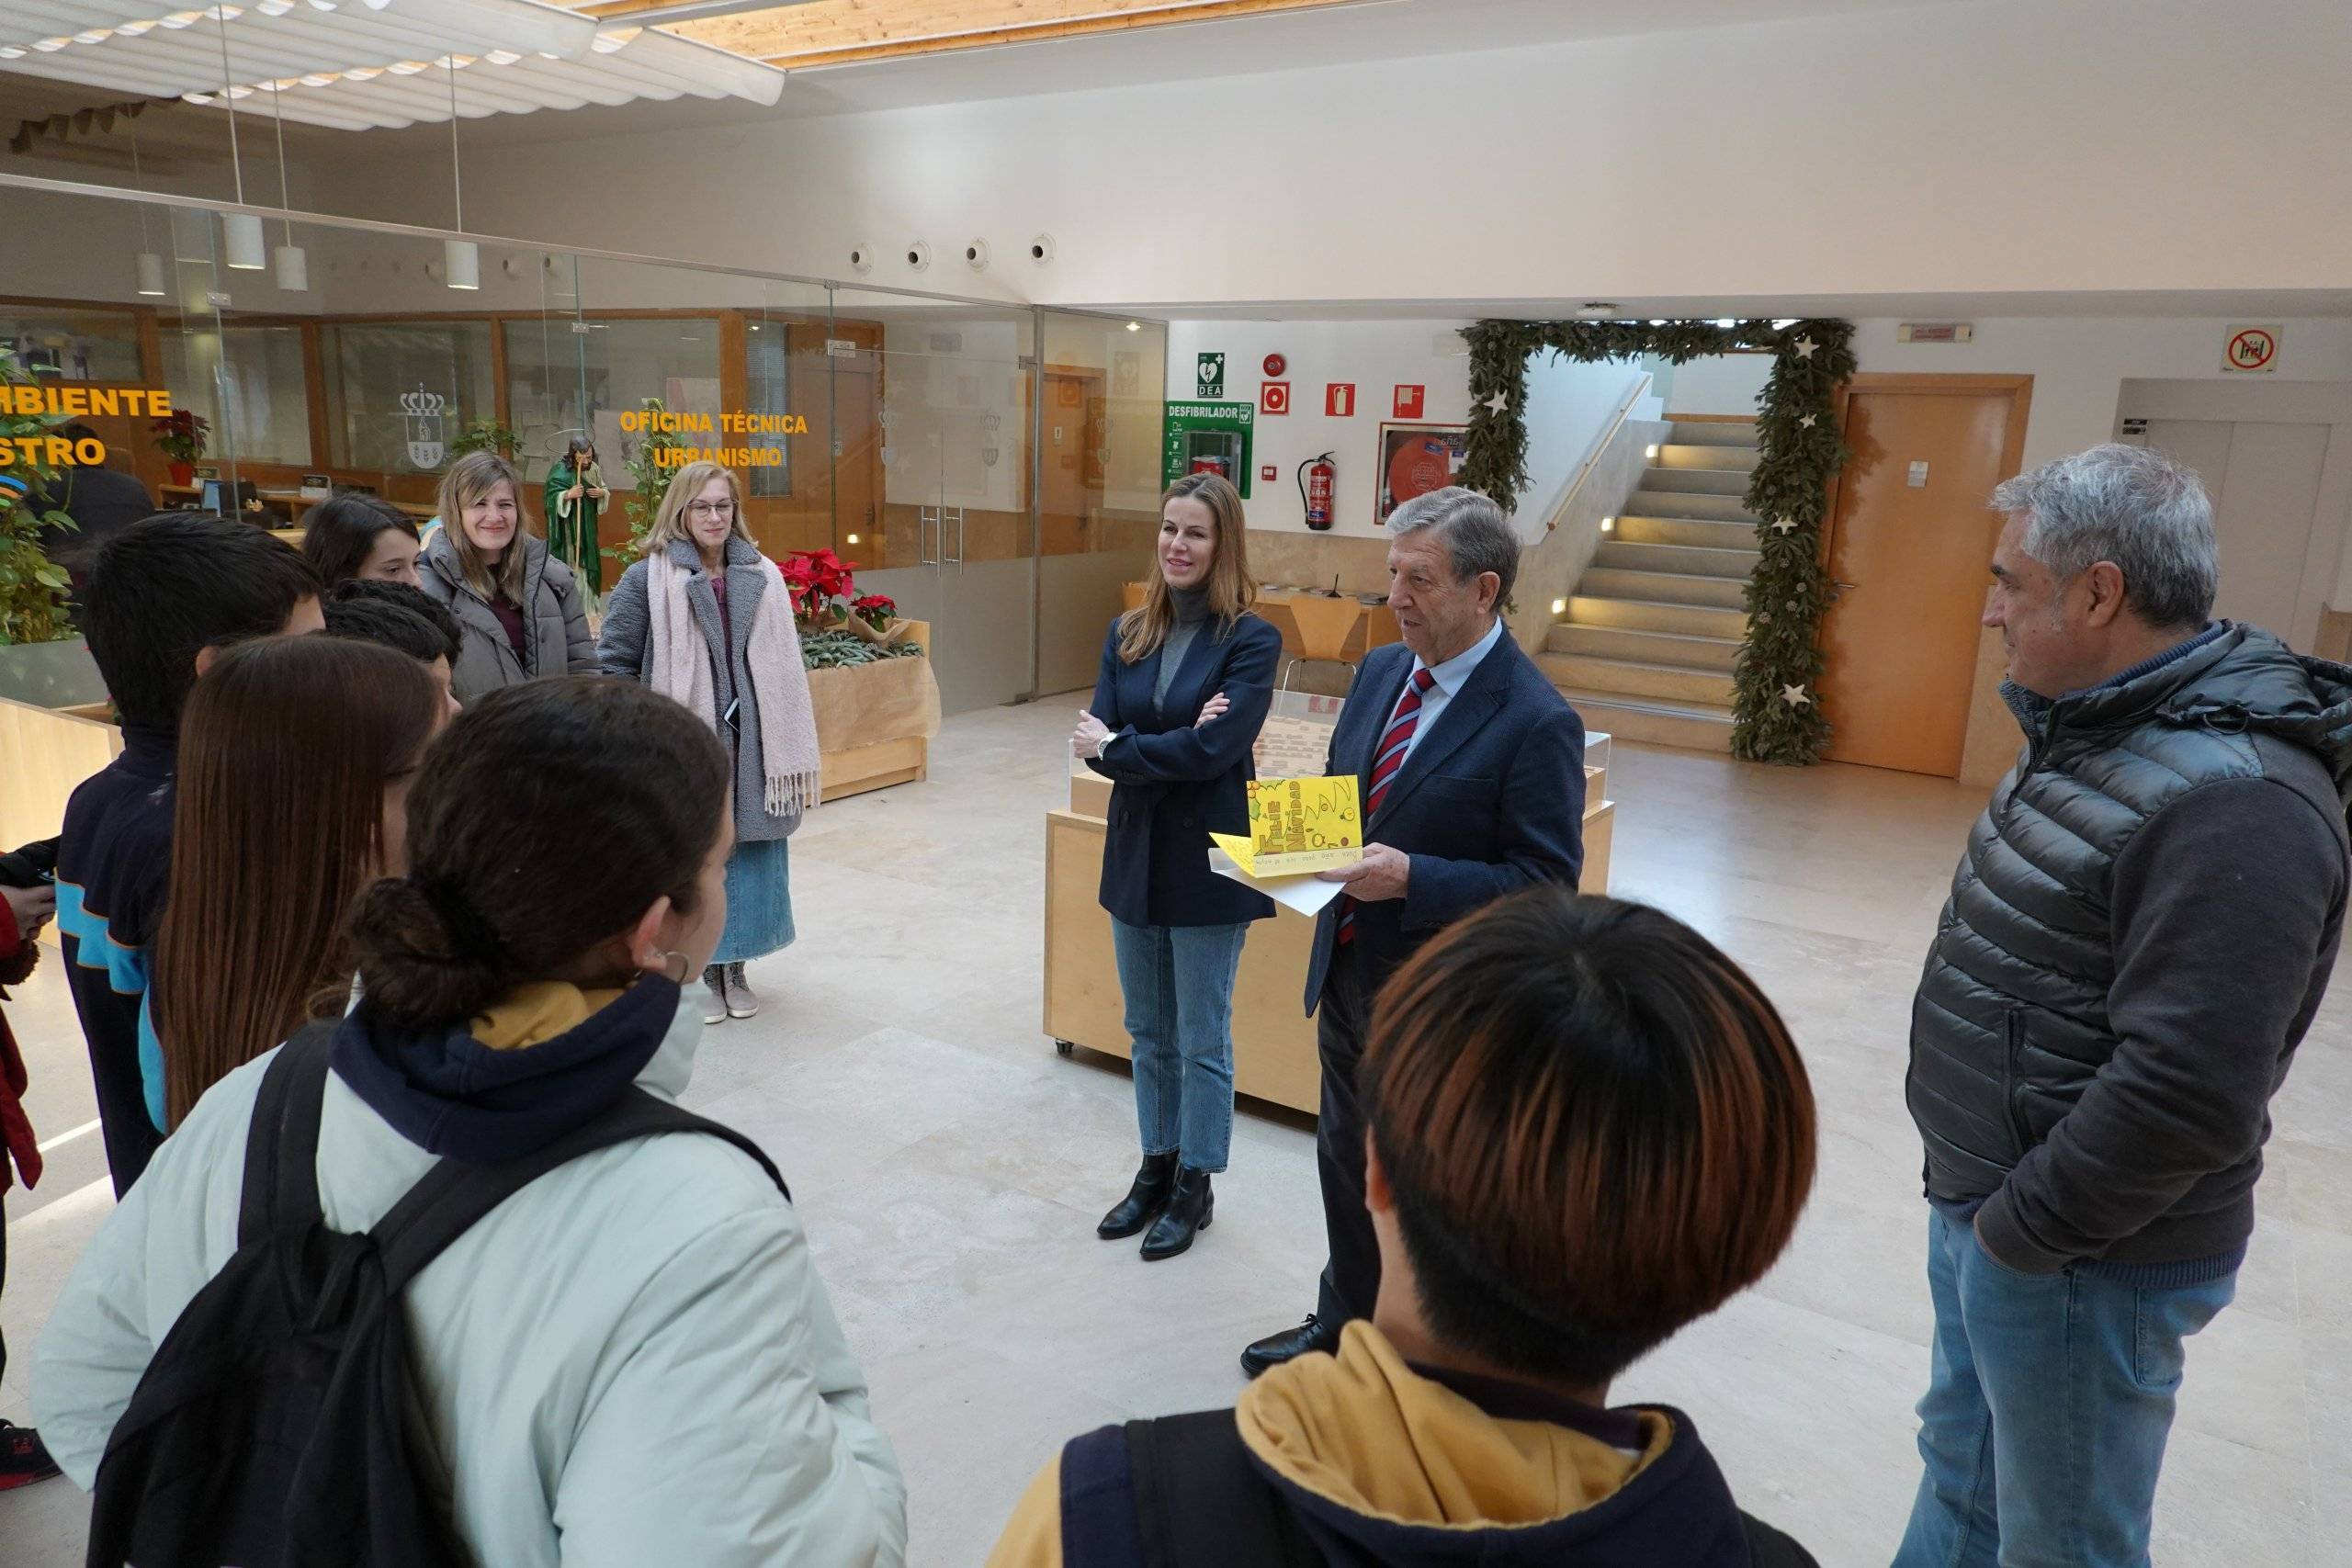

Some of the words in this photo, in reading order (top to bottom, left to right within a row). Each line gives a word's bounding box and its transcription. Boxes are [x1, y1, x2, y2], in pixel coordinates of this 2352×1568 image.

[1198, 386, 1222, 395] DEA
[1169, 405, 1238, 419] DESFIBRILADOR
[620, 411, 714, 433] OFICINA
[719, 410, 808, 434] TÉCNICA
[655, 447, 782, 468] URBANISMO
